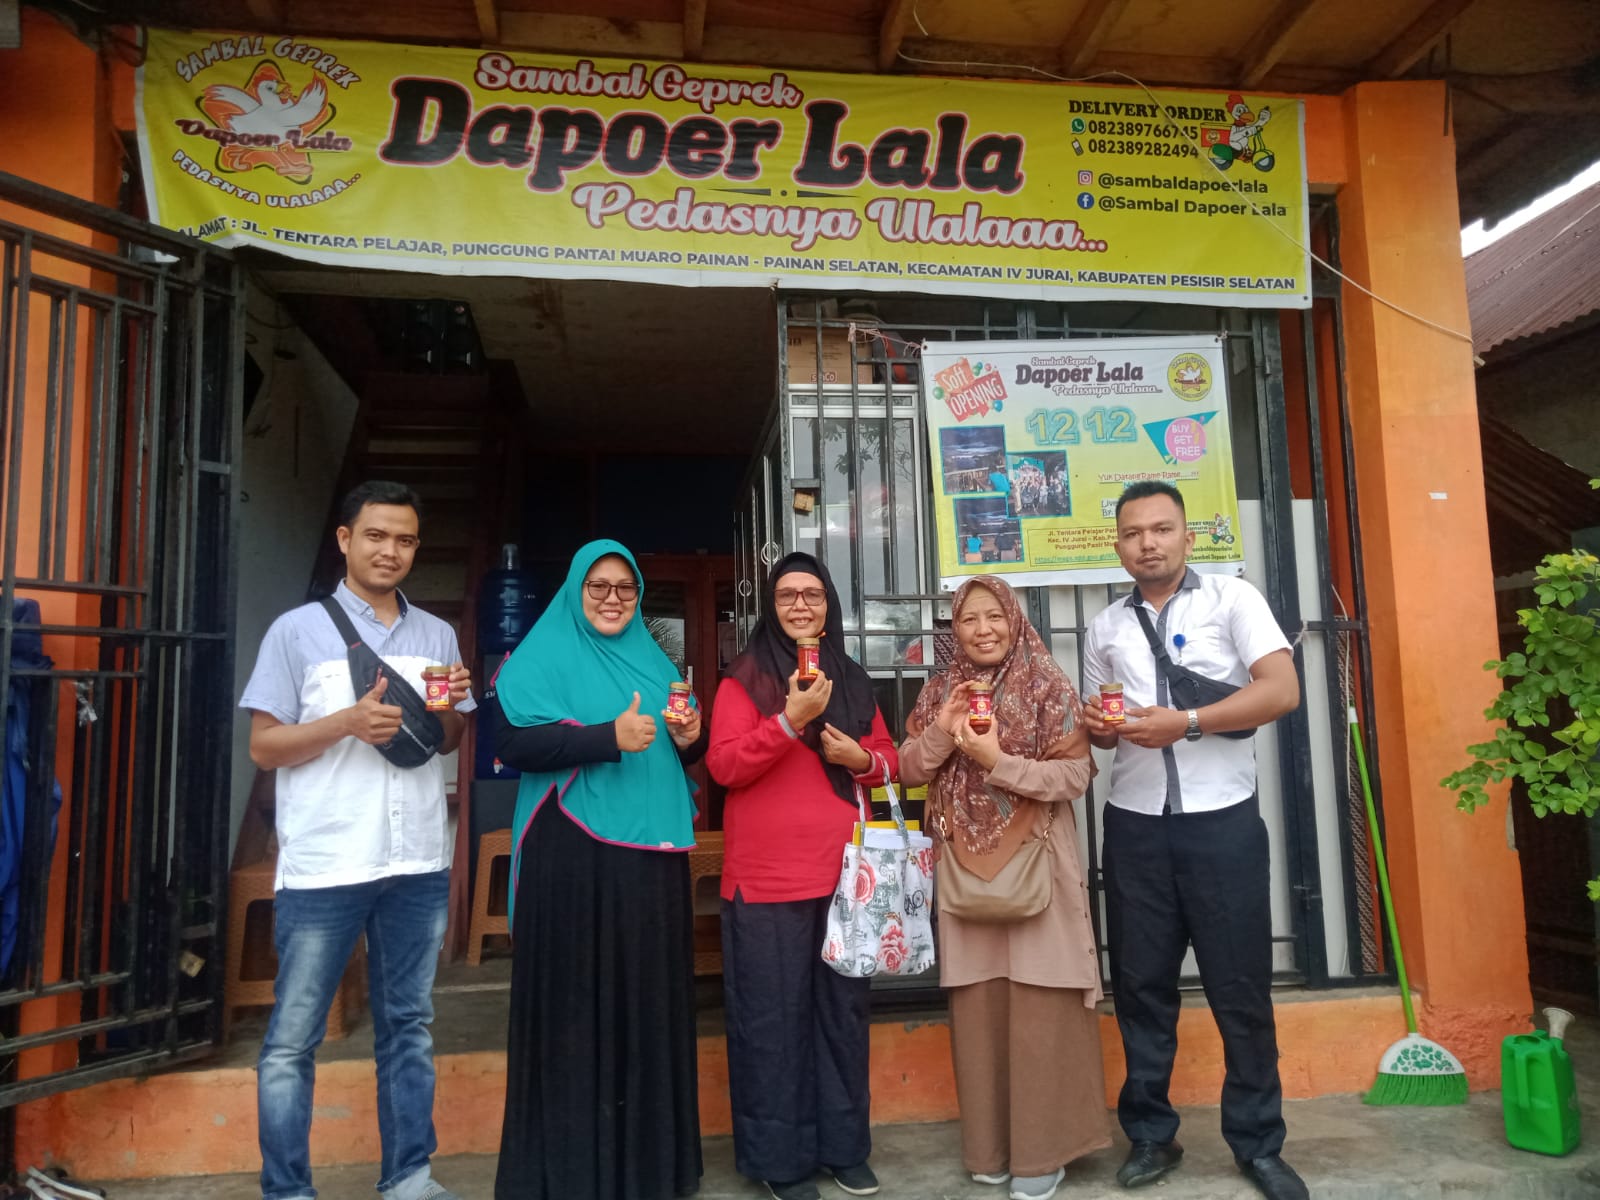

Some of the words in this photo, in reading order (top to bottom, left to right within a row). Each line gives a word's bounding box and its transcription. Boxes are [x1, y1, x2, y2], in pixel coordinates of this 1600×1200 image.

[175, 36, 266, 82] SAMBAL
[273, 37, 361, 89] GEPREK
[475, 52, 650, 99] Sambal
[651, 64, 804, 113] Geprek
[1068, 100, 1160, 118] DELIVERY
[1165, 105, 1227, 122] ORDER
[175, 117, 282, 151] Dapoer
[288, 129, 352, 151] Lala
[377, 76, 782, 193] Dapoer
[792, 98, 1026, 195] Lala
[1088, 120, 1199, 140] 082389766745
[1088, 139, 1199, 158] 082389282494
[172, 149, 260, 205] PEDASNYA
[1098, 173, 1269, 194] @sambaldapoerlala
[571, 182, 859, 251] Pedasnya
[1098, 196, 1179, 213] @Sambal
[1184, 201, 1247, 217] Dapoer
[1252, 203, 1286, 216] Lala
[273, 228, 358, 249] TENTARA
[363, 236, 448, 257] PELAJAR,
[453, 242, 549, 258] PUNGGUNG
[554, 247, 616, 262] PANTAI
[621, 249, 682, 264] MUARO
[687, 252, 749, 267] PAINAN
[764, 255, 825, 270] PAINAN
[829, 259, 903, 275] SELATAN,
[908, 263, 1002, 279] KECAMATAN
[1006, 267, 1022, 280] IV
[1026, 268, 1074, 283] JURAI,
[1077, 271, 1167, 286] KABUPATEN
[1171, 275, 1225, 288] PESISIR
[1229, 278, 1295, 289] SELATAN
[941, 366, 969, 391] Soft
[1015, 364, 1093, 388] Dapoer
[1096, 362, 1144, 382] Lala
[950, 377, 1004, 416] OPENING
[1052, 384, 1111, 398] Pedasnya
[1026, 408, 1080, 446] 12
[1084, 406, 1138, 443] 12
[1172, 424, 1190, 434] BUY
[1174, 434, 1192, 445] GET
[1175, 446, 1201, 457] FREE
